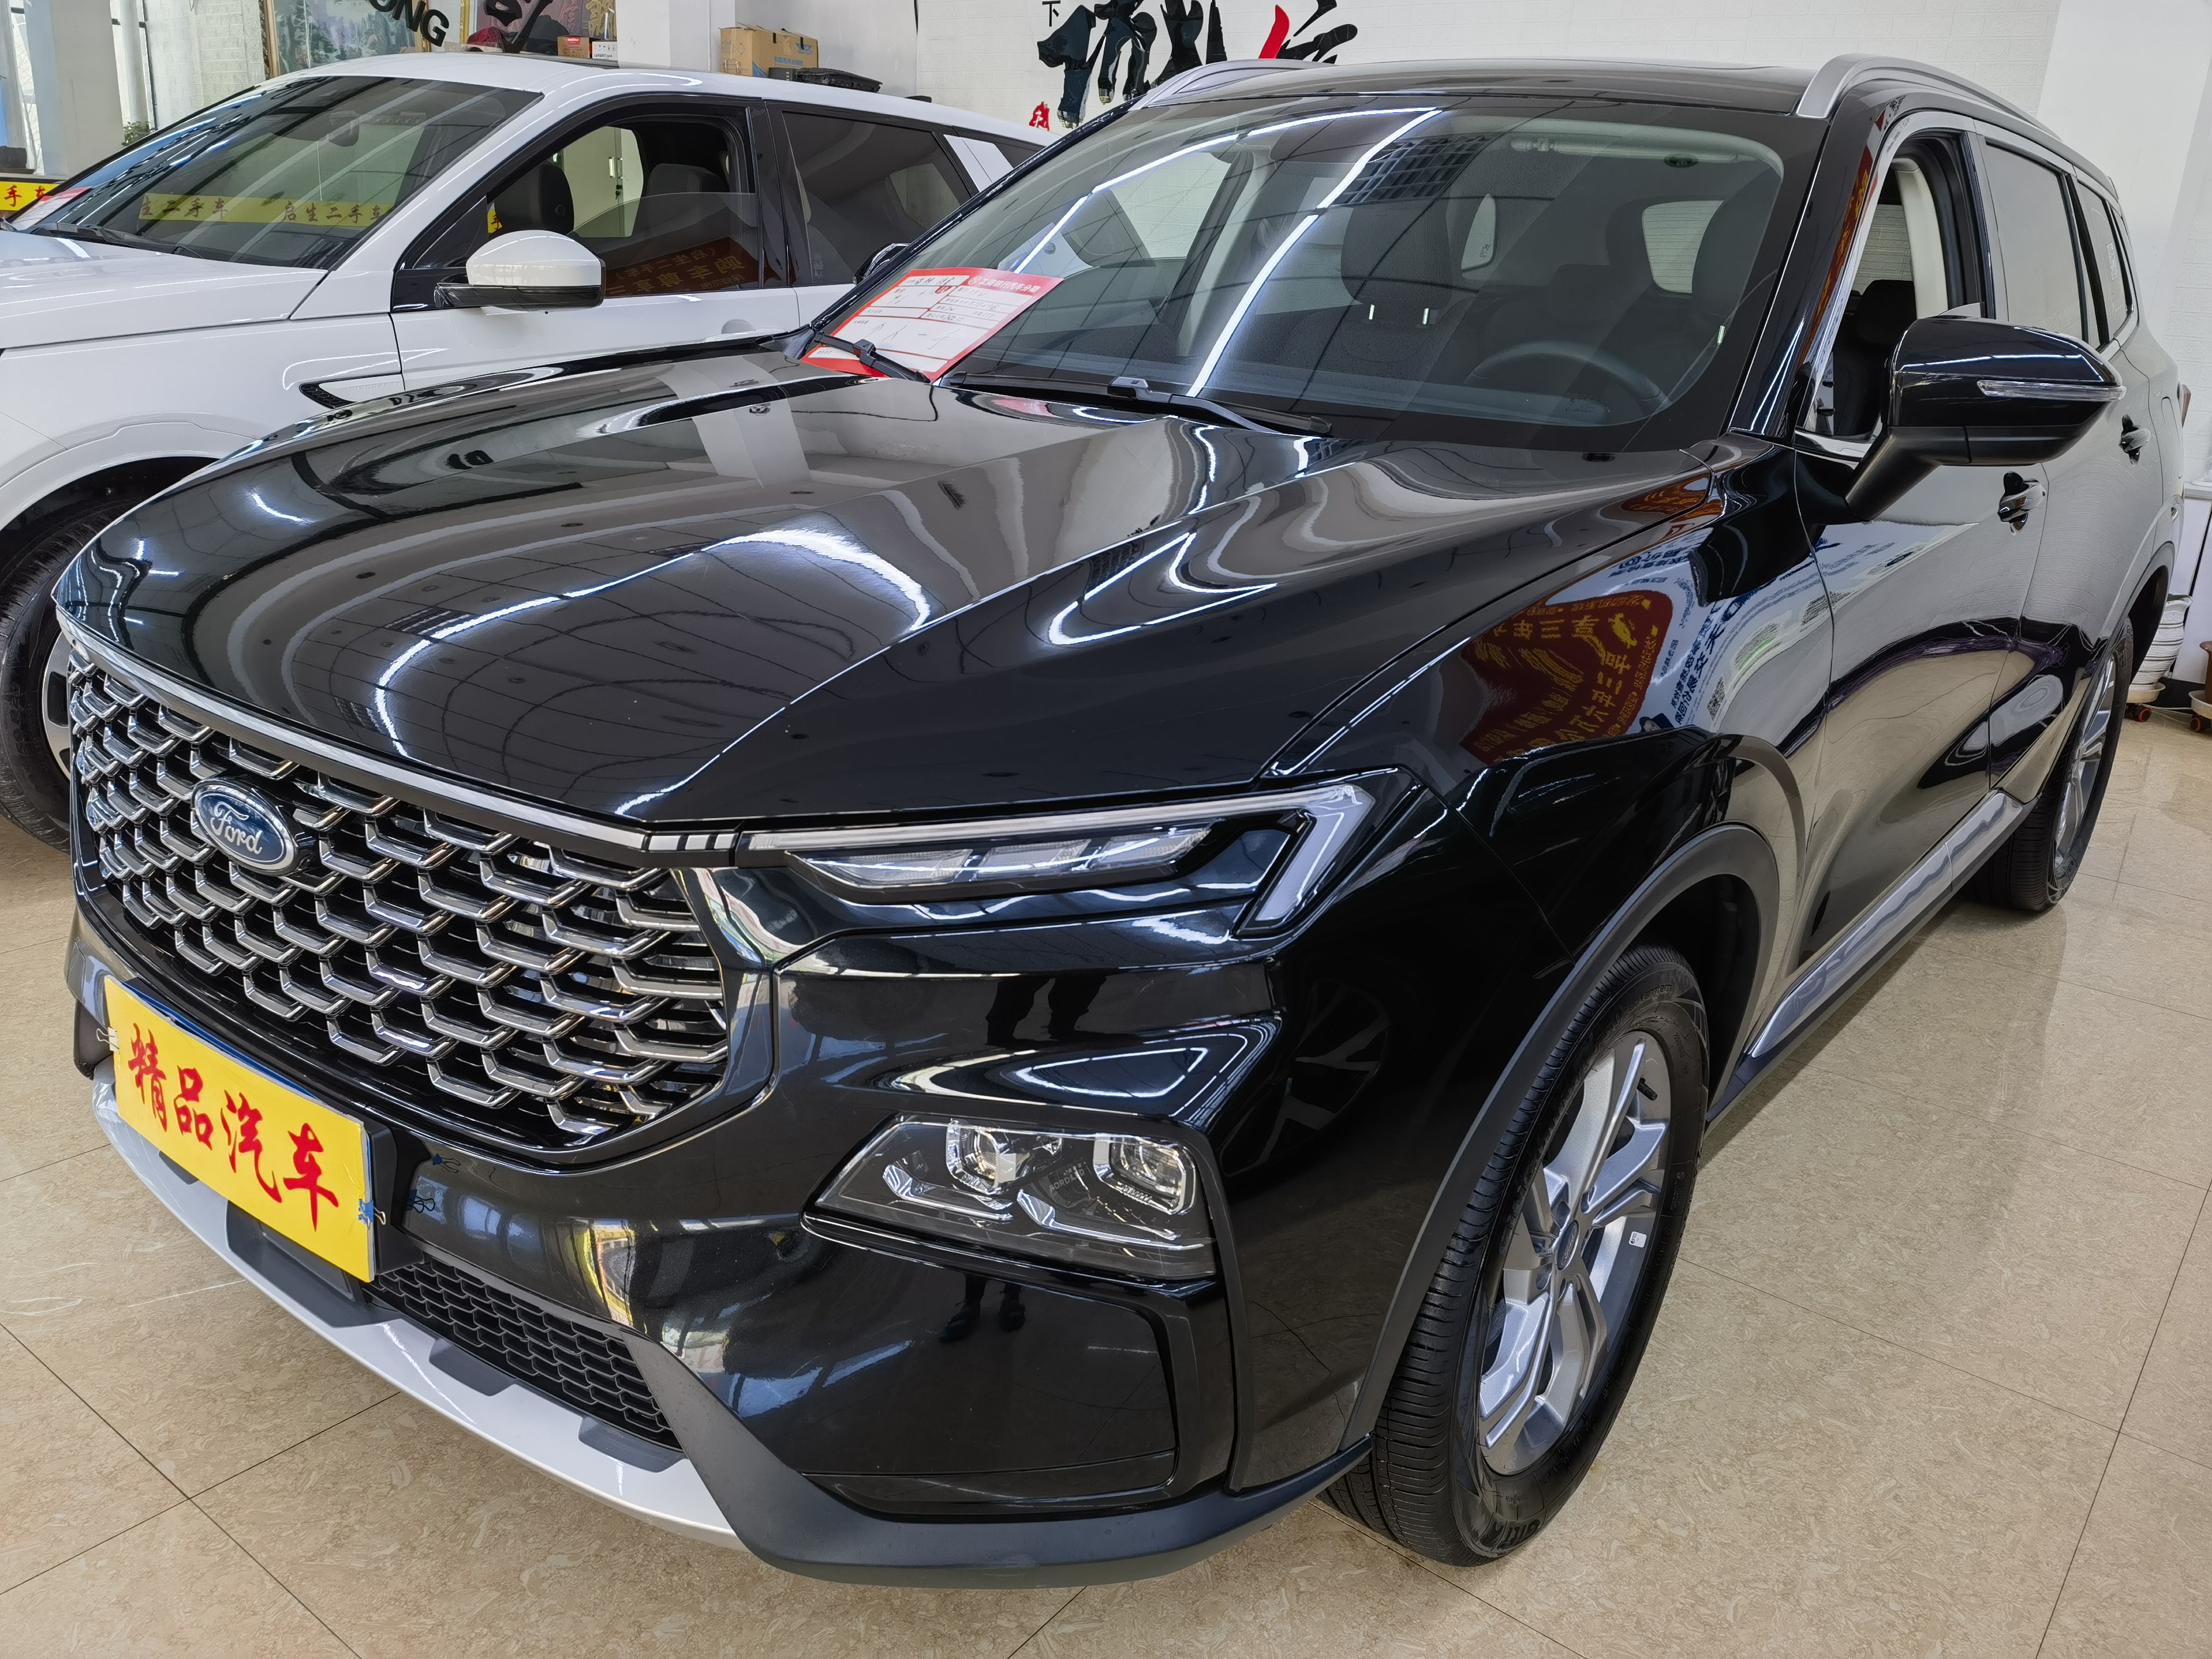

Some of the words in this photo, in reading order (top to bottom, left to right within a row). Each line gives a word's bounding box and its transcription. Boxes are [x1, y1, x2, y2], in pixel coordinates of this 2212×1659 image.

[1042, 1, 1061, 26] 下
[210, 801, 264, 855] Ford
[127, 1022, 339, 1232] 精品汽车
[1070, 1168, 1085, 1182] LD
